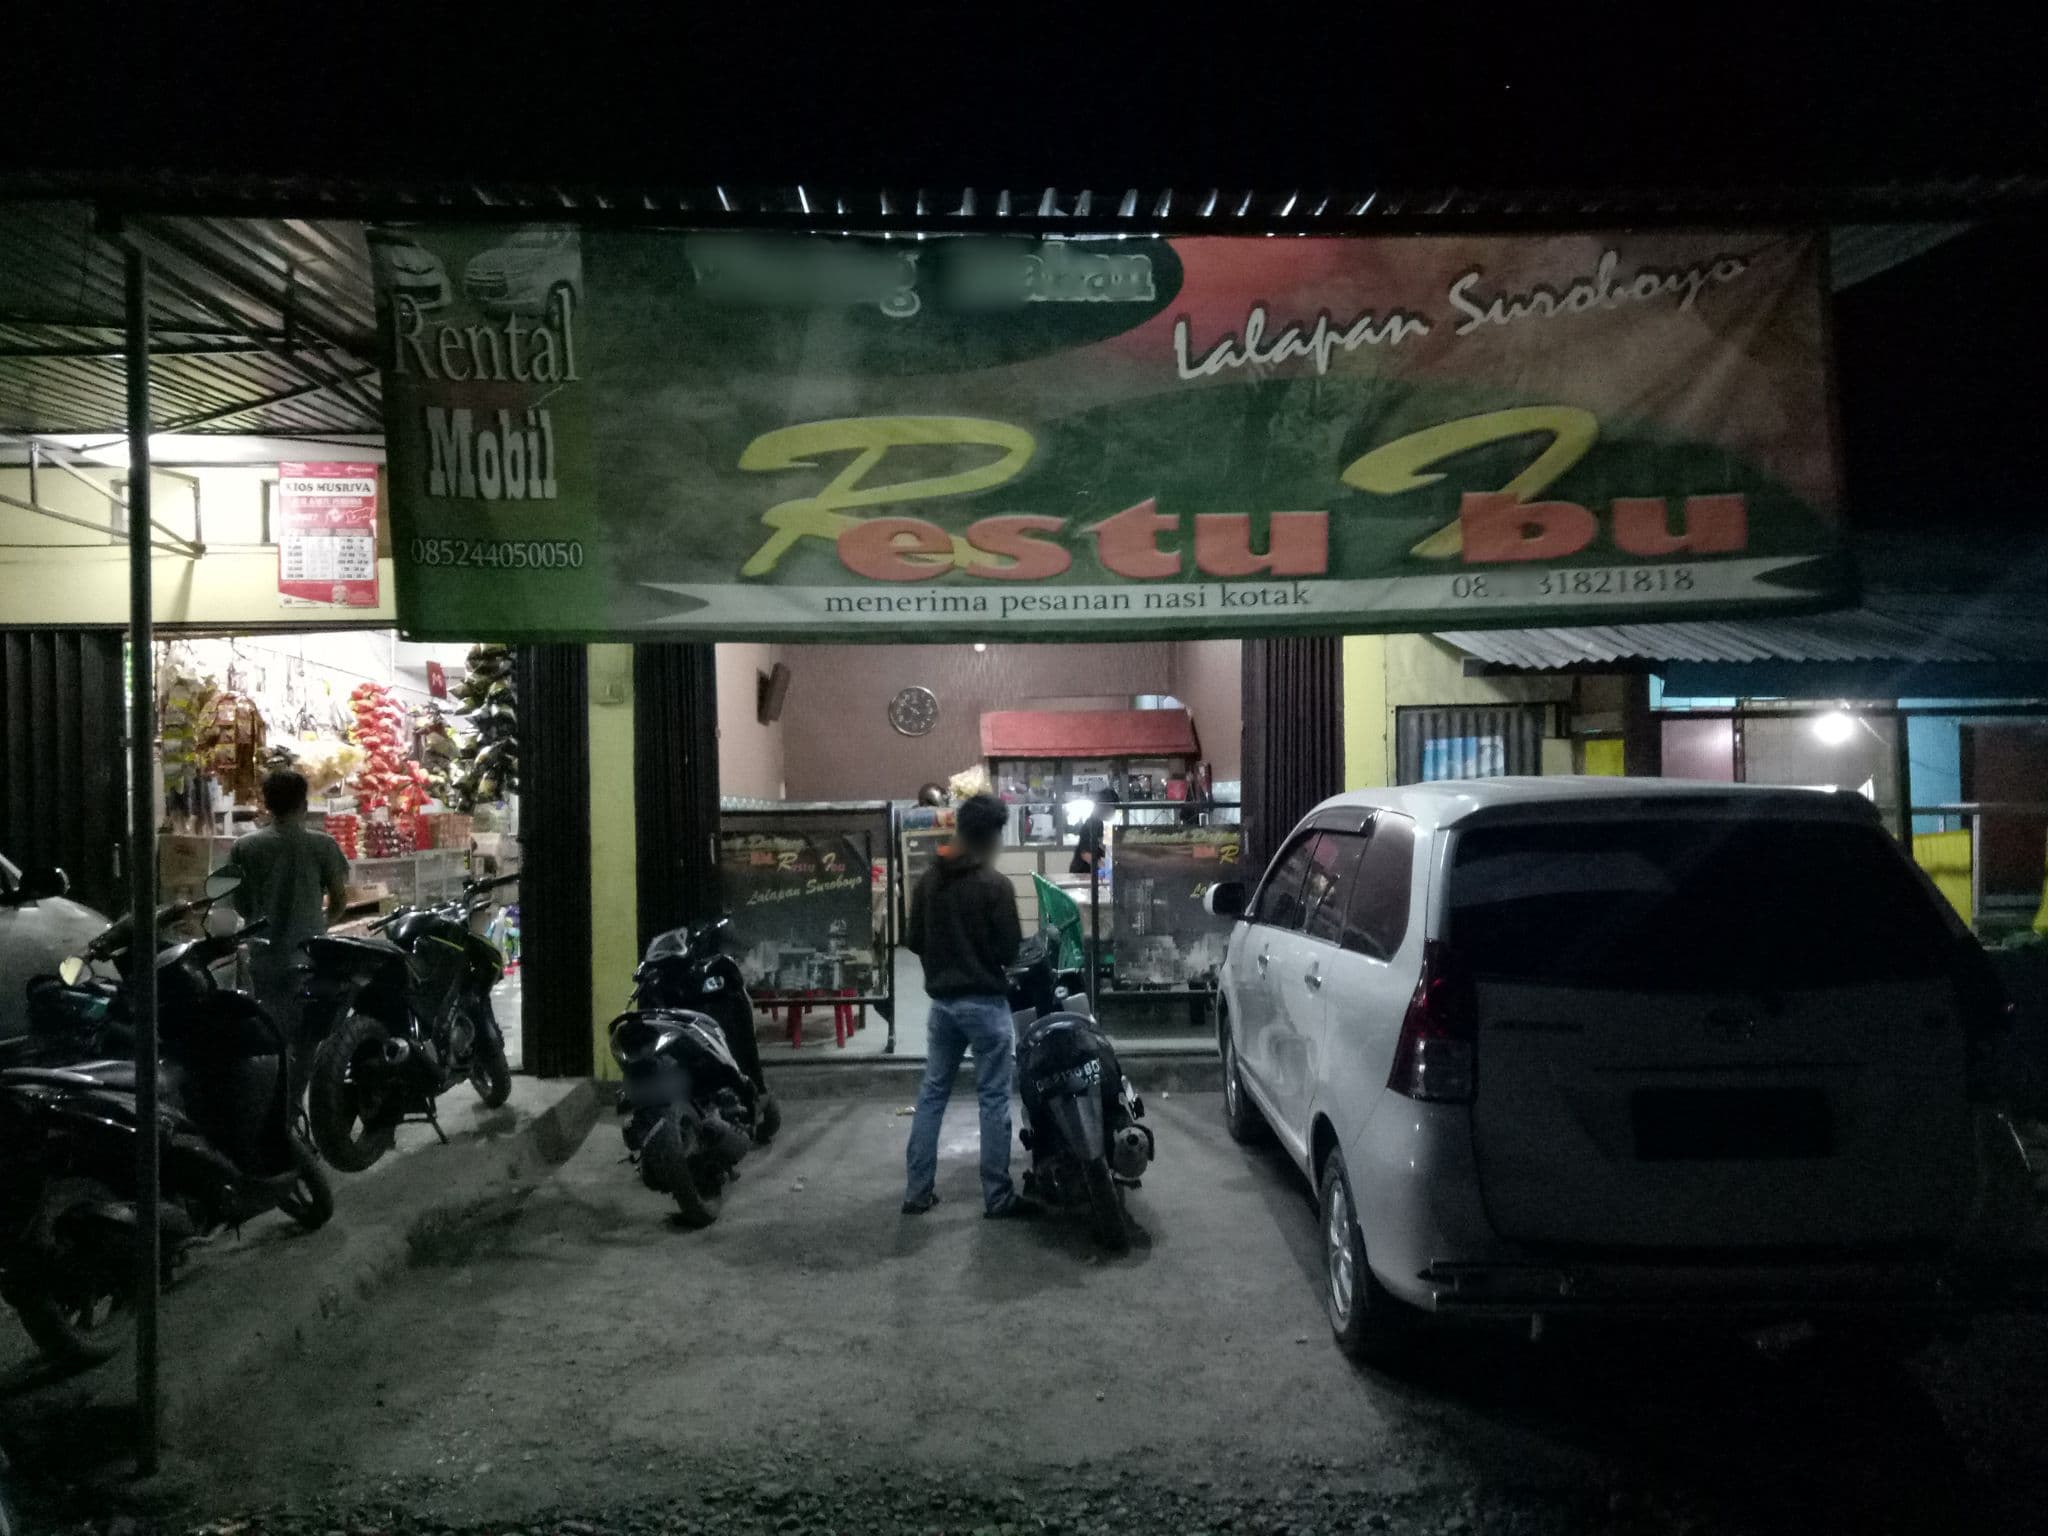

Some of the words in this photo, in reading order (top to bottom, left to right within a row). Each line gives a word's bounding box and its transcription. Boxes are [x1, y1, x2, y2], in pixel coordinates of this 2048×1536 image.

[393, 288, 582, 383] Rental
[1174, 308, 1429, 380] Lalapan
[1448, 249, 1748, 337] Suroboyo
[426, 407, 557, 500] Mobil
[738, 415, 1329, 581] Restu
[411, 538, 583, 569] 085244050050
[825, 589, 987, 614] menerima
[1001, 590, 1130, 617] pesanan
[1145, 584, 1207, 609] nasi
[1220, 581, 1312, 607] kotak
